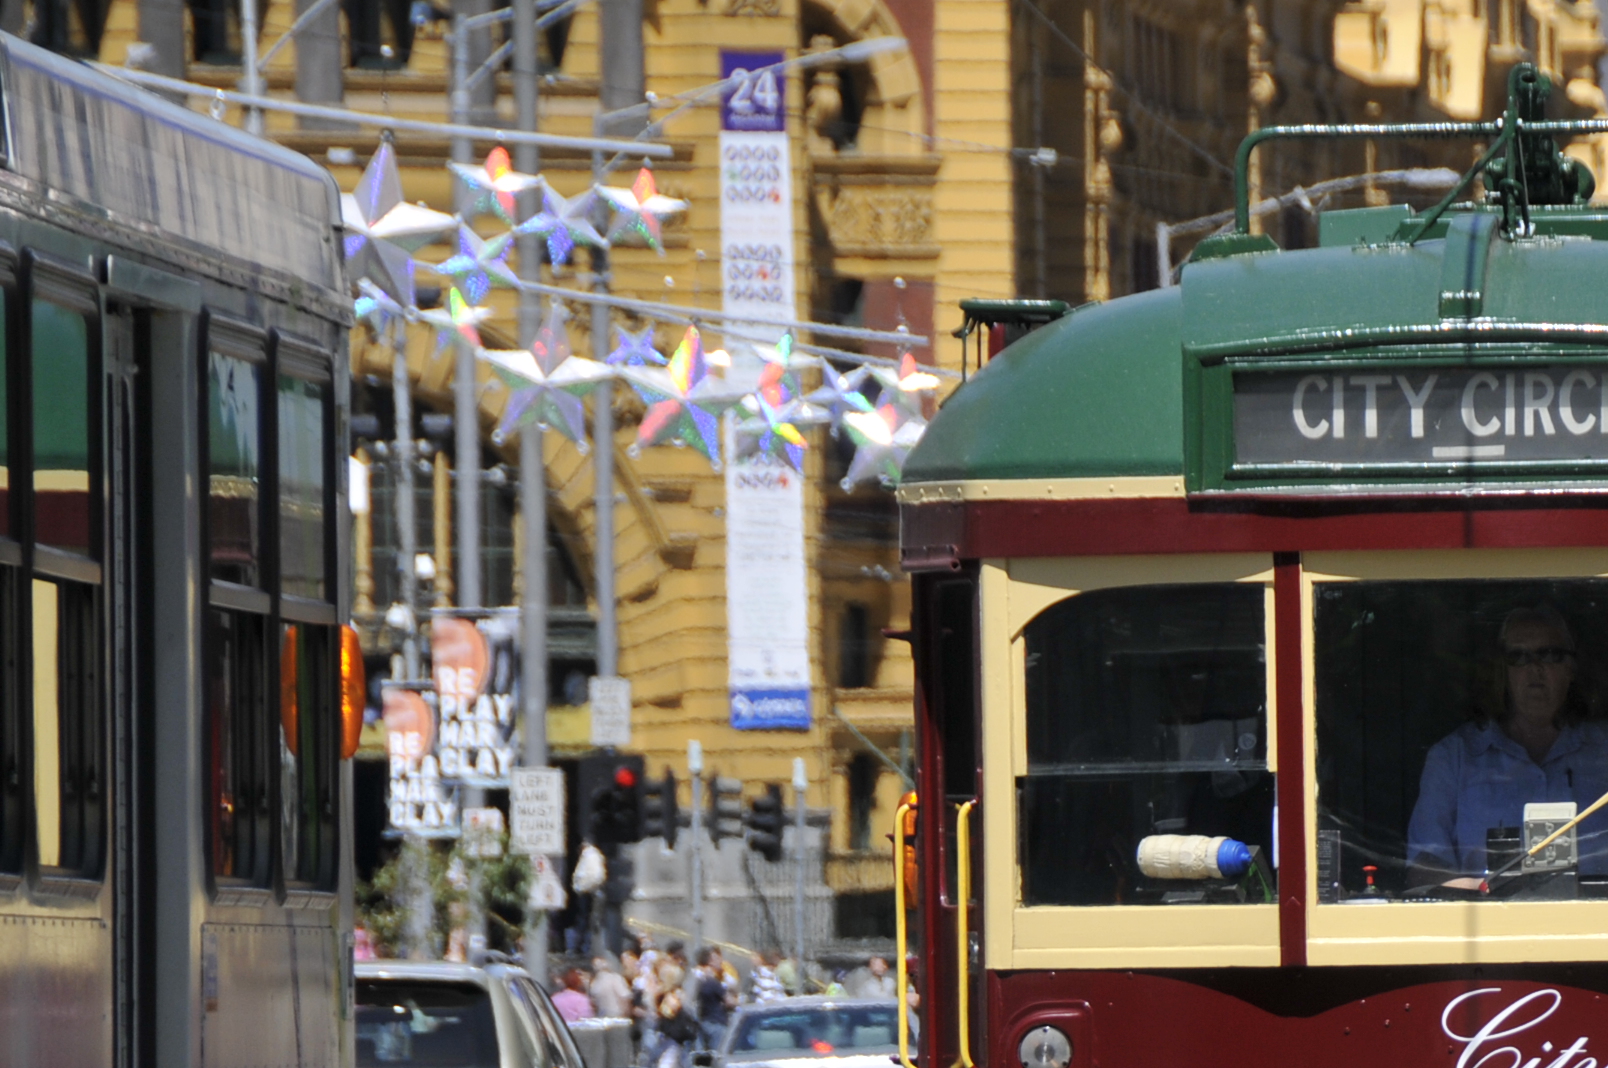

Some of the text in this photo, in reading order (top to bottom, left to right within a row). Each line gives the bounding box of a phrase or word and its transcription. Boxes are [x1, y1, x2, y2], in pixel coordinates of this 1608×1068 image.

[729, 68, 779, 113] 24
[1293, 374, 1438, 439] CITY
[438, 666, 477, 696] RE
[440, 693, 513, 724] PLAY
